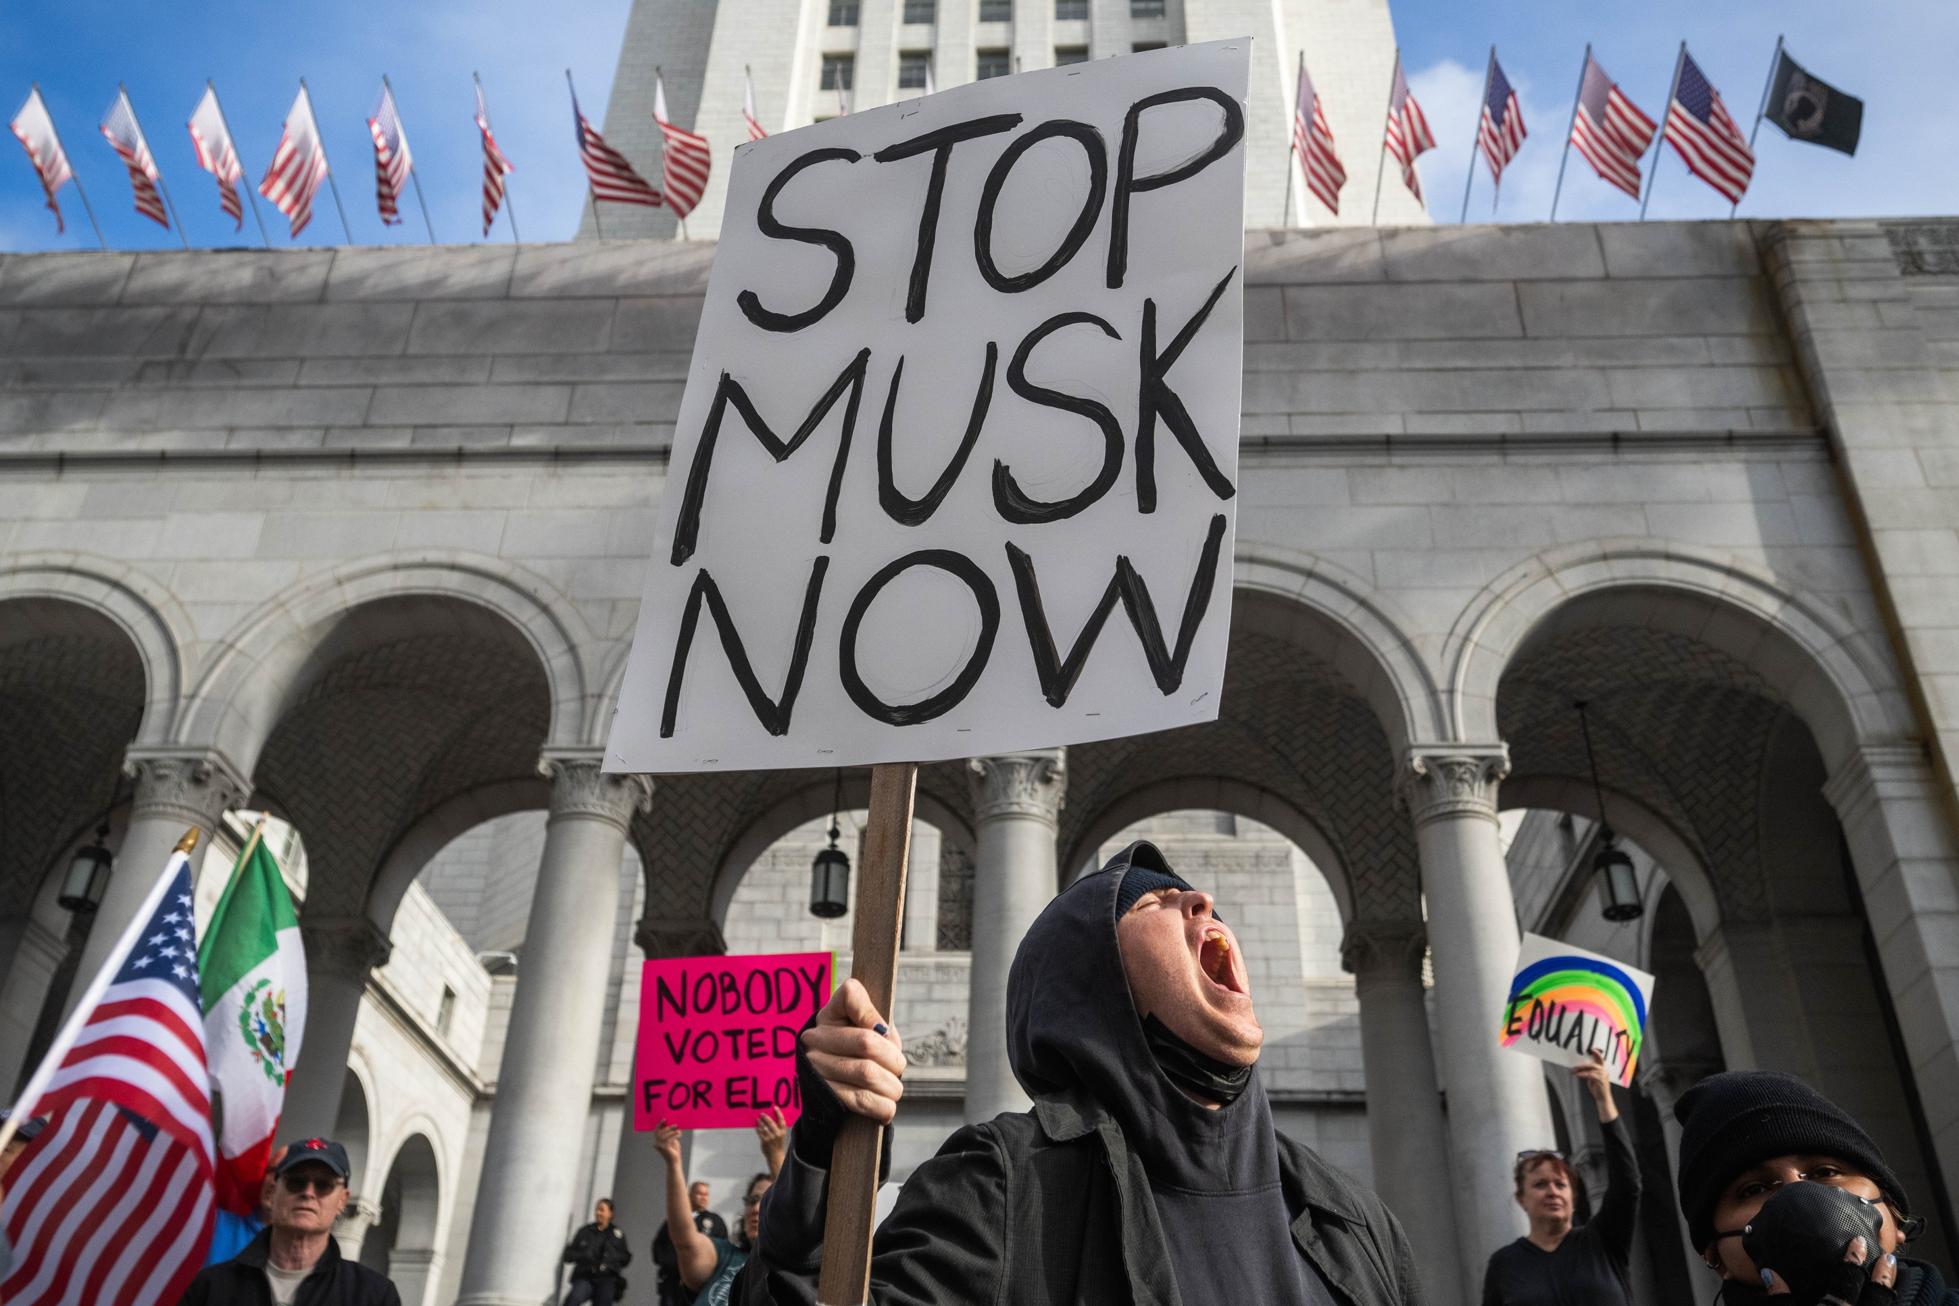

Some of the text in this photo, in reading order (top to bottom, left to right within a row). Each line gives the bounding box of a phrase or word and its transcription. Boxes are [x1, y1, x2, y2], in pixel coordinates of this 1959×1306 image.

[737, 86, 1245, 332] STOP
[670, 265, 1236, 566] MUSK
[660, 513, 1226, 738] NOW
[656, 964, 826, 1022] NOBODY
[664, 1026, 797, 1064] VOTED
[1506, 994, 1636, 1079] EQUALITY
[643, 1079, 713, 1113] FOR
